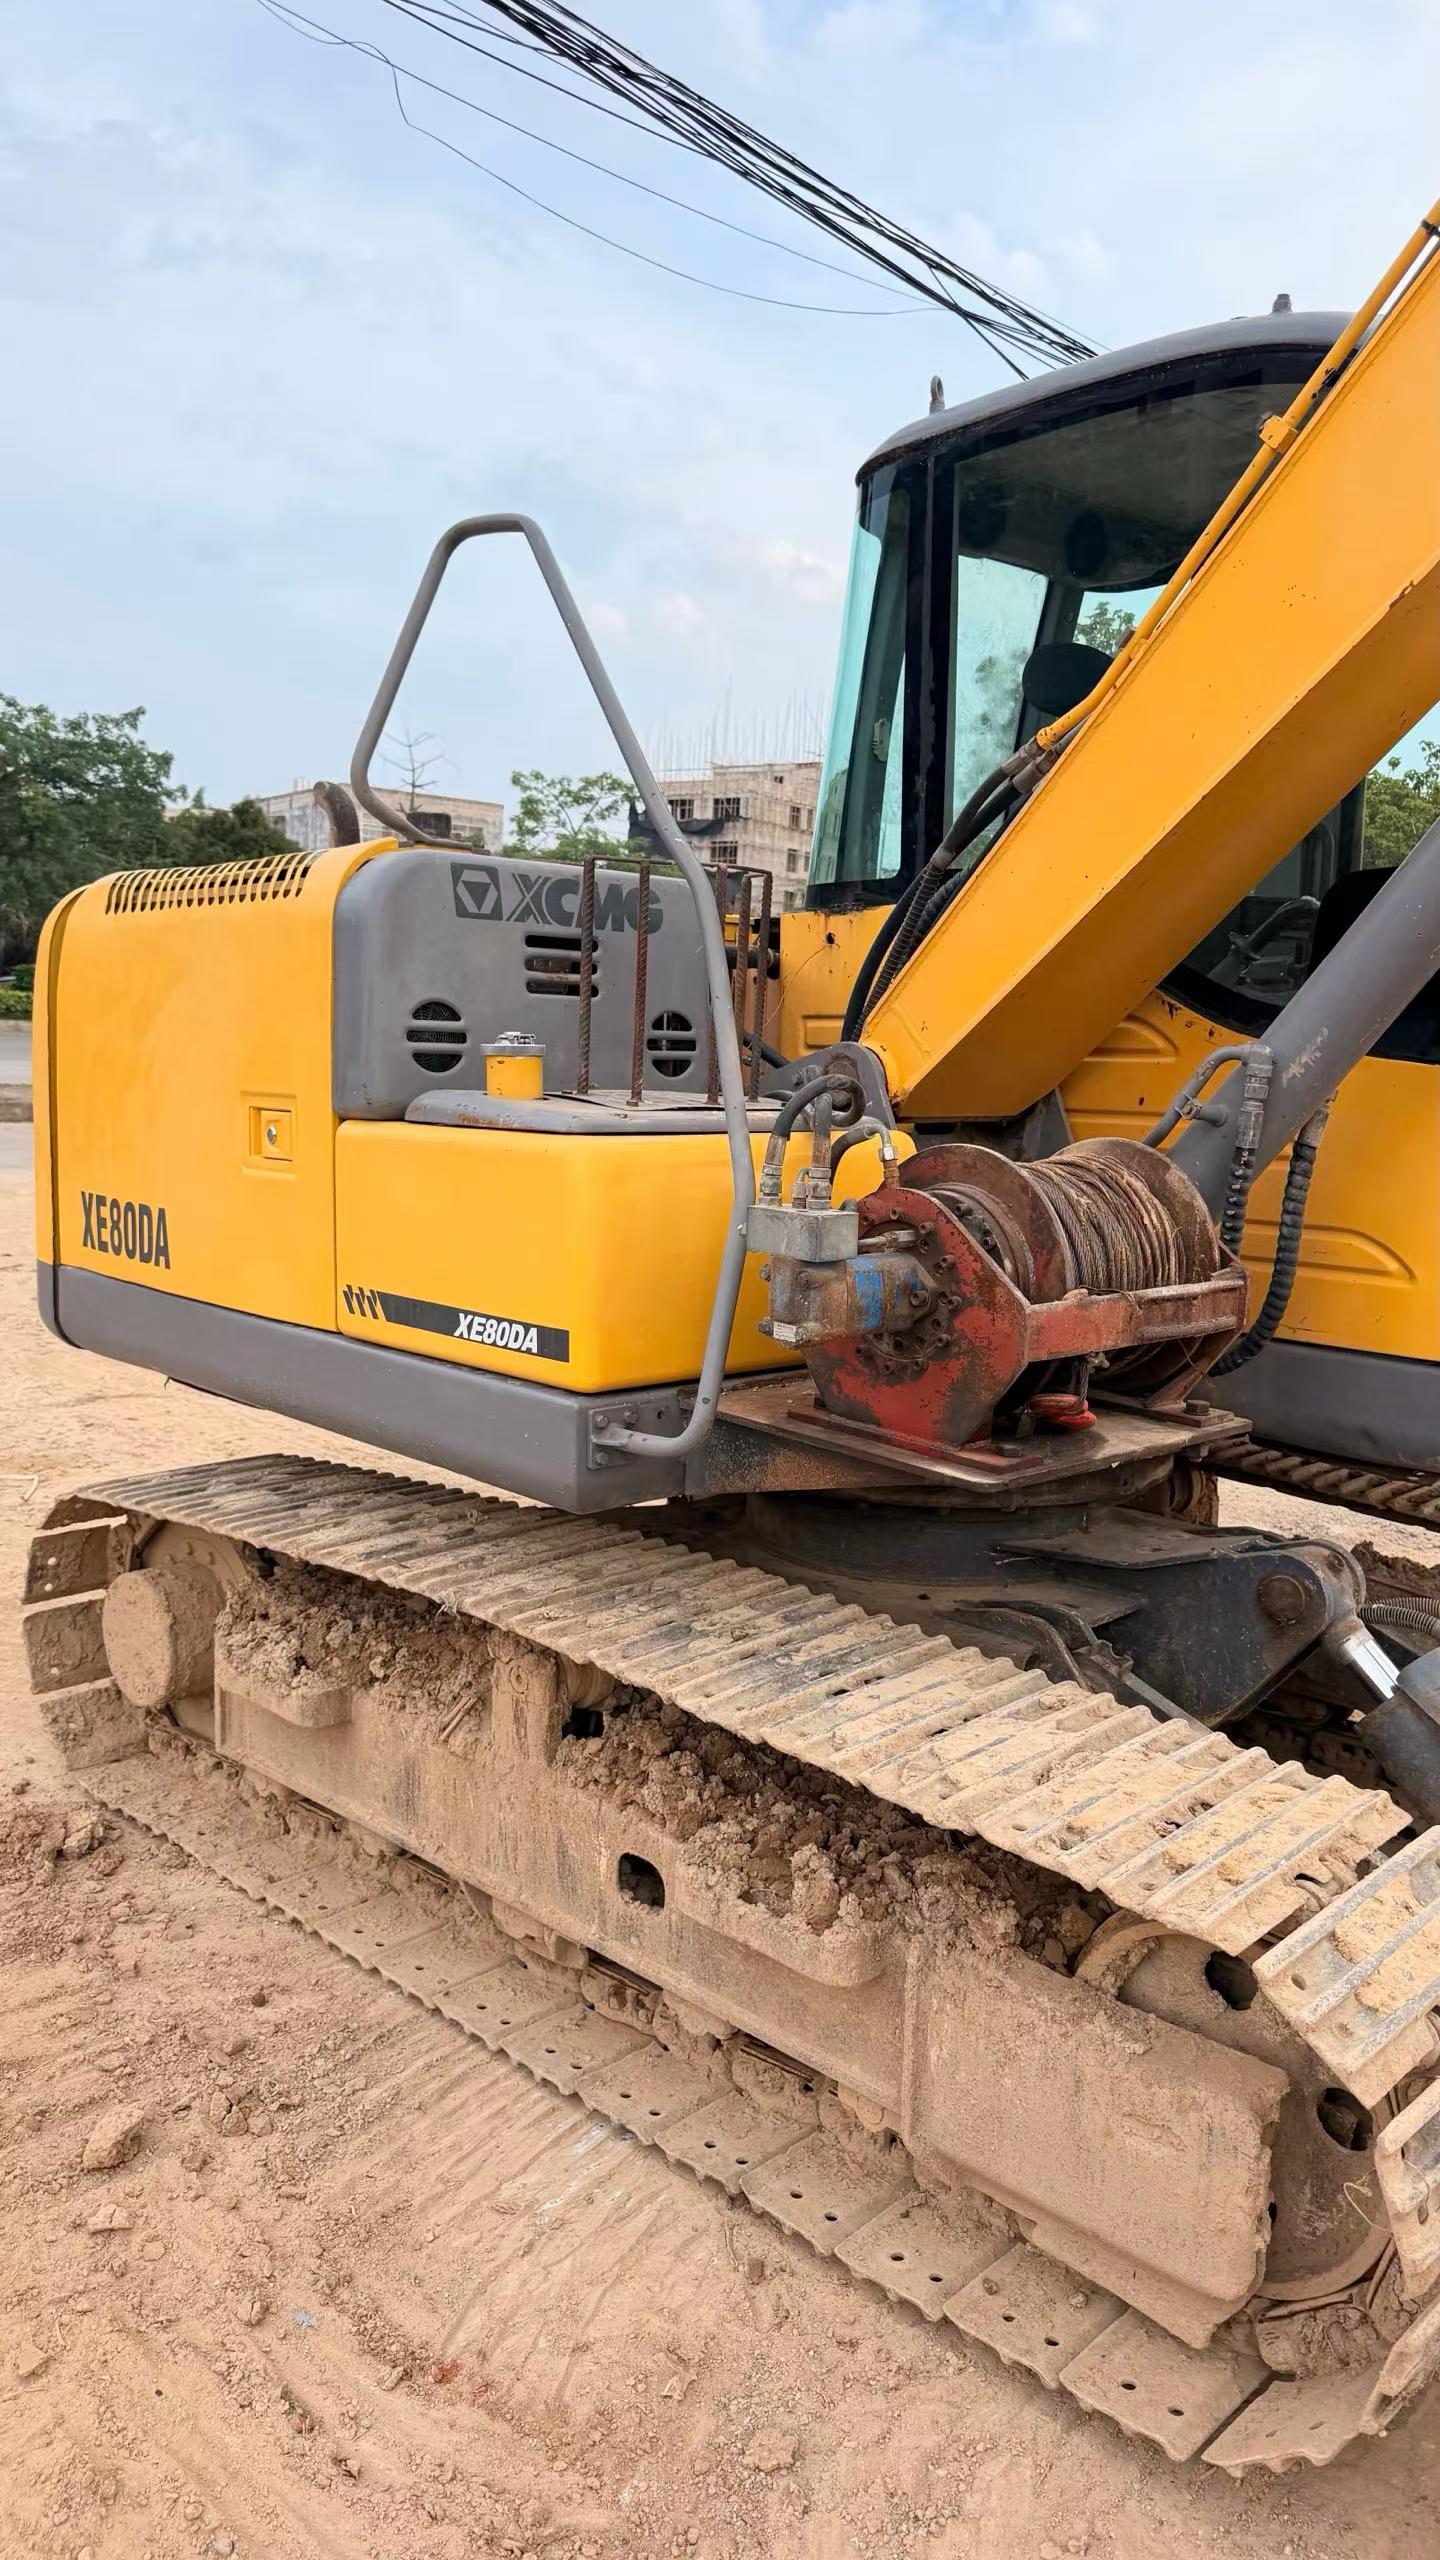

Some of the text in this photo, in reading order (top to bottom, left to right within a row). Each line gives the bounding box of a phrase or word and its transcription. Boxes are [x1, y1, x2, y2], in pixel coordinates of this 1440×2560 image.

[506, 873, 664, 934] XCMG
[80, 1190, 171, 1269] XE80DA
[453, 1312, 539, 1354] XE80DA
